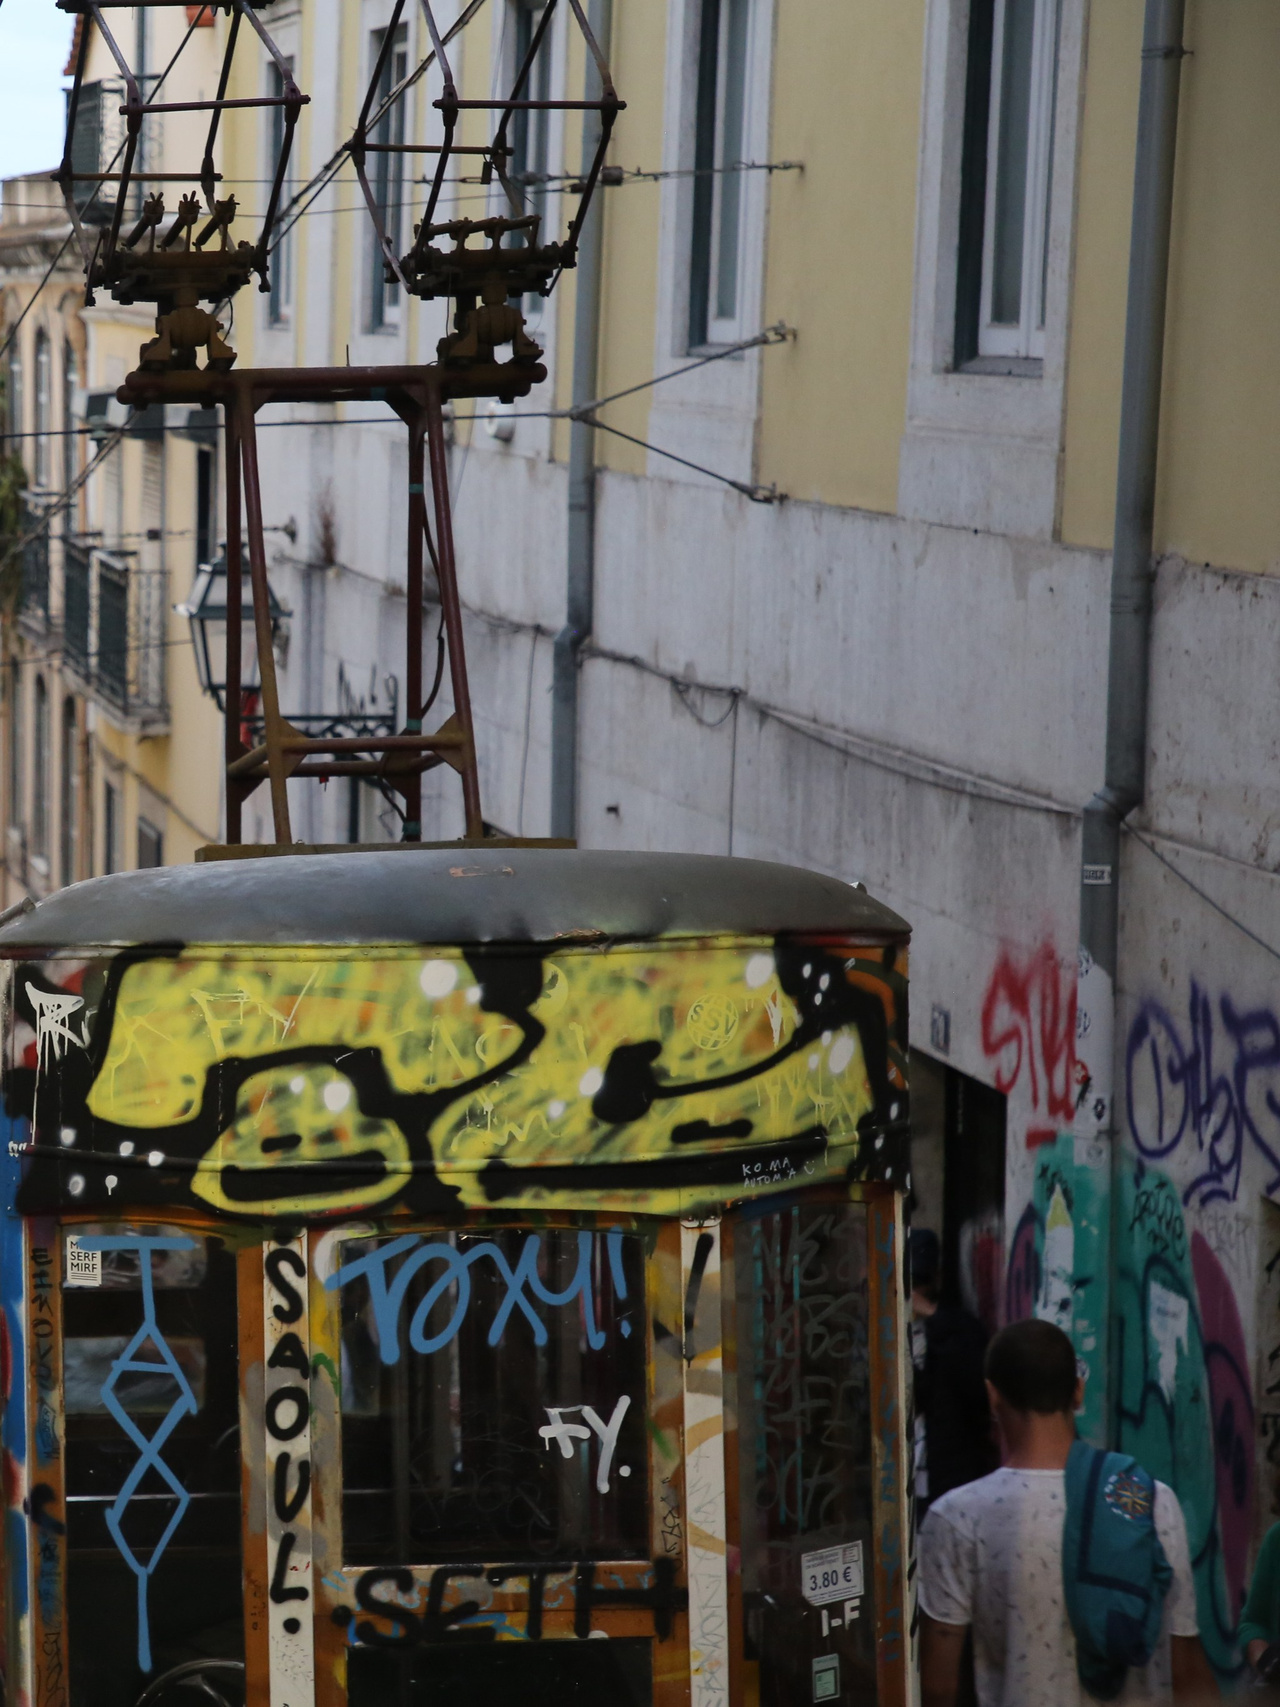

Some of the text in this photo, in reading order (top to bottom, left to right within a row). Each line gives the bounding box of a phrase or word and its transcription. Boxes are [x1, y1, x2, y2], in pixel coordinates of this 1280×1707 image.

[70, 1251, 98, 1263] SERF
[70, 1262, 98, 1274] MIRF
[809, 1566, 853, 1591] 3.80 €
